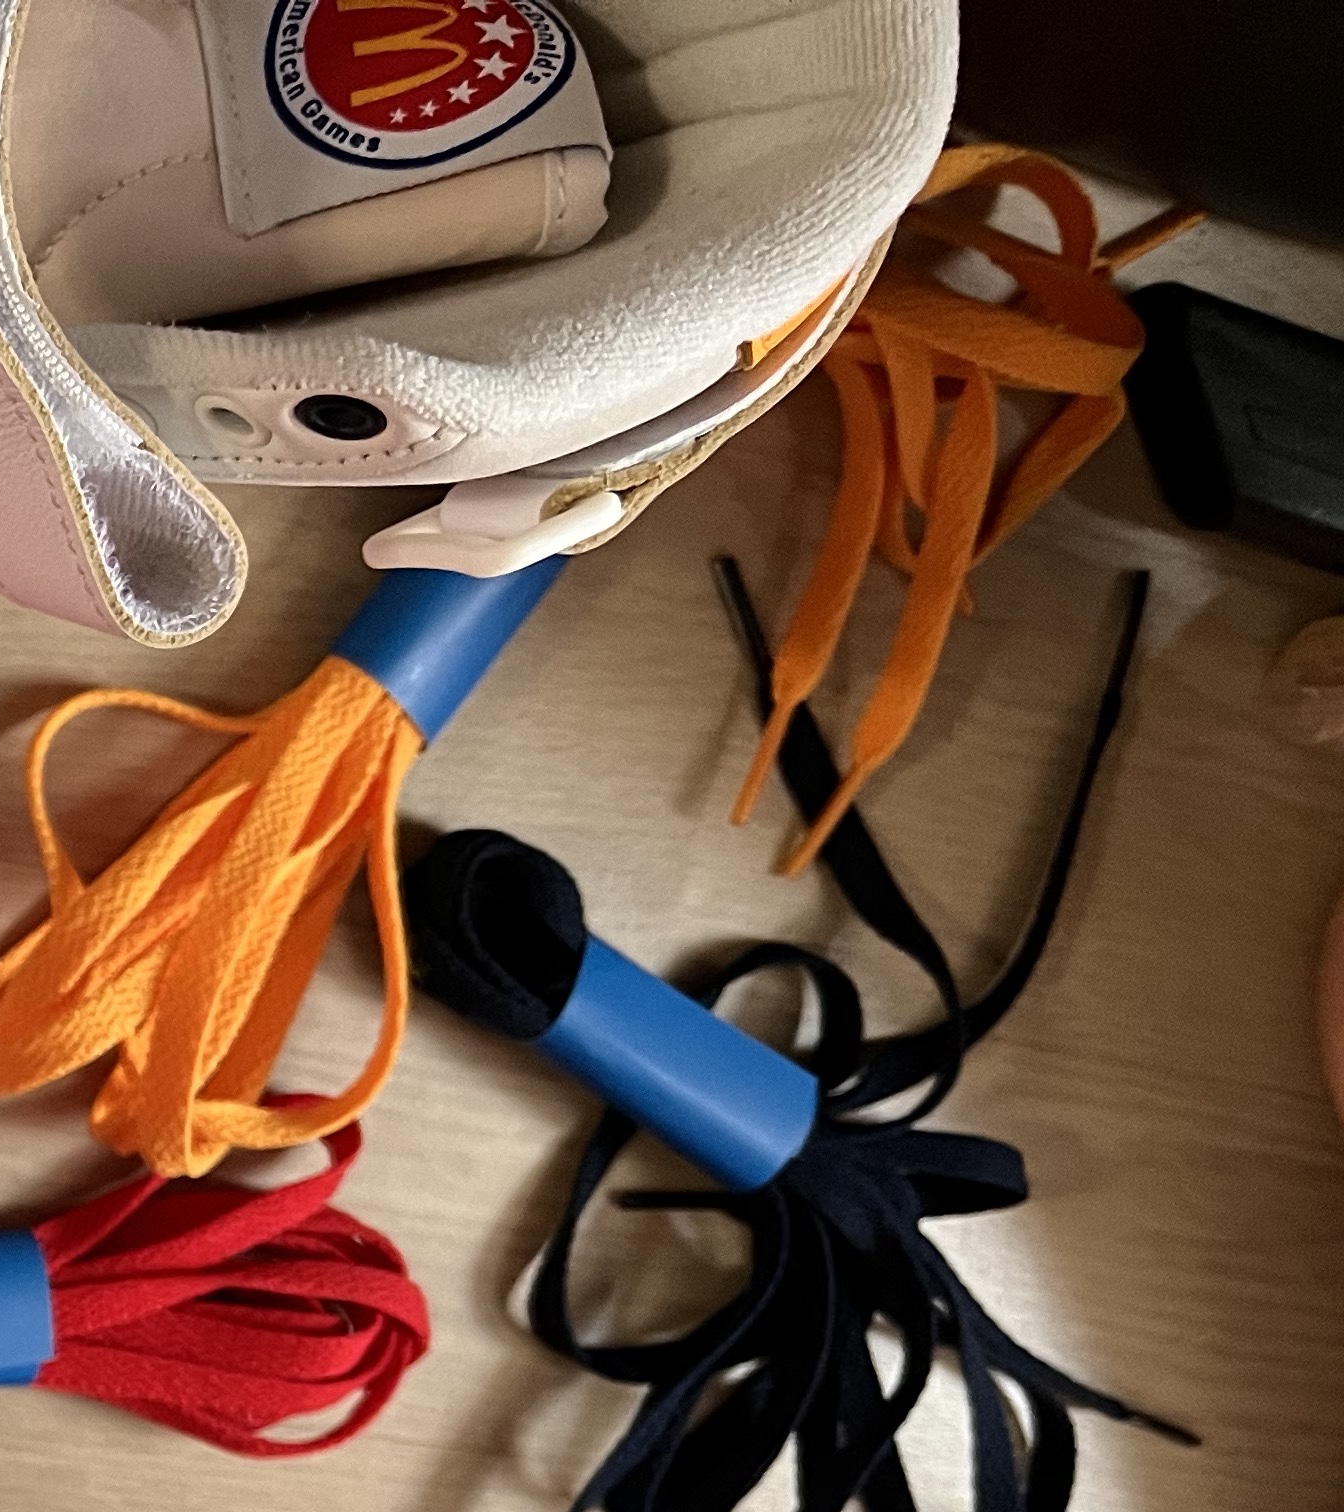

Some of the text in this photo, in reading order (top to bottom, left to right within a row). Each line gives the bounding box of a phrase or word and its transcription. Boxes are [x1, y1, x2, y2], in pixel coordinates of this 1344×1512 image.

[278, 0, 381, 153] merican Games
[509, 0, 562, 85] cDonald's
